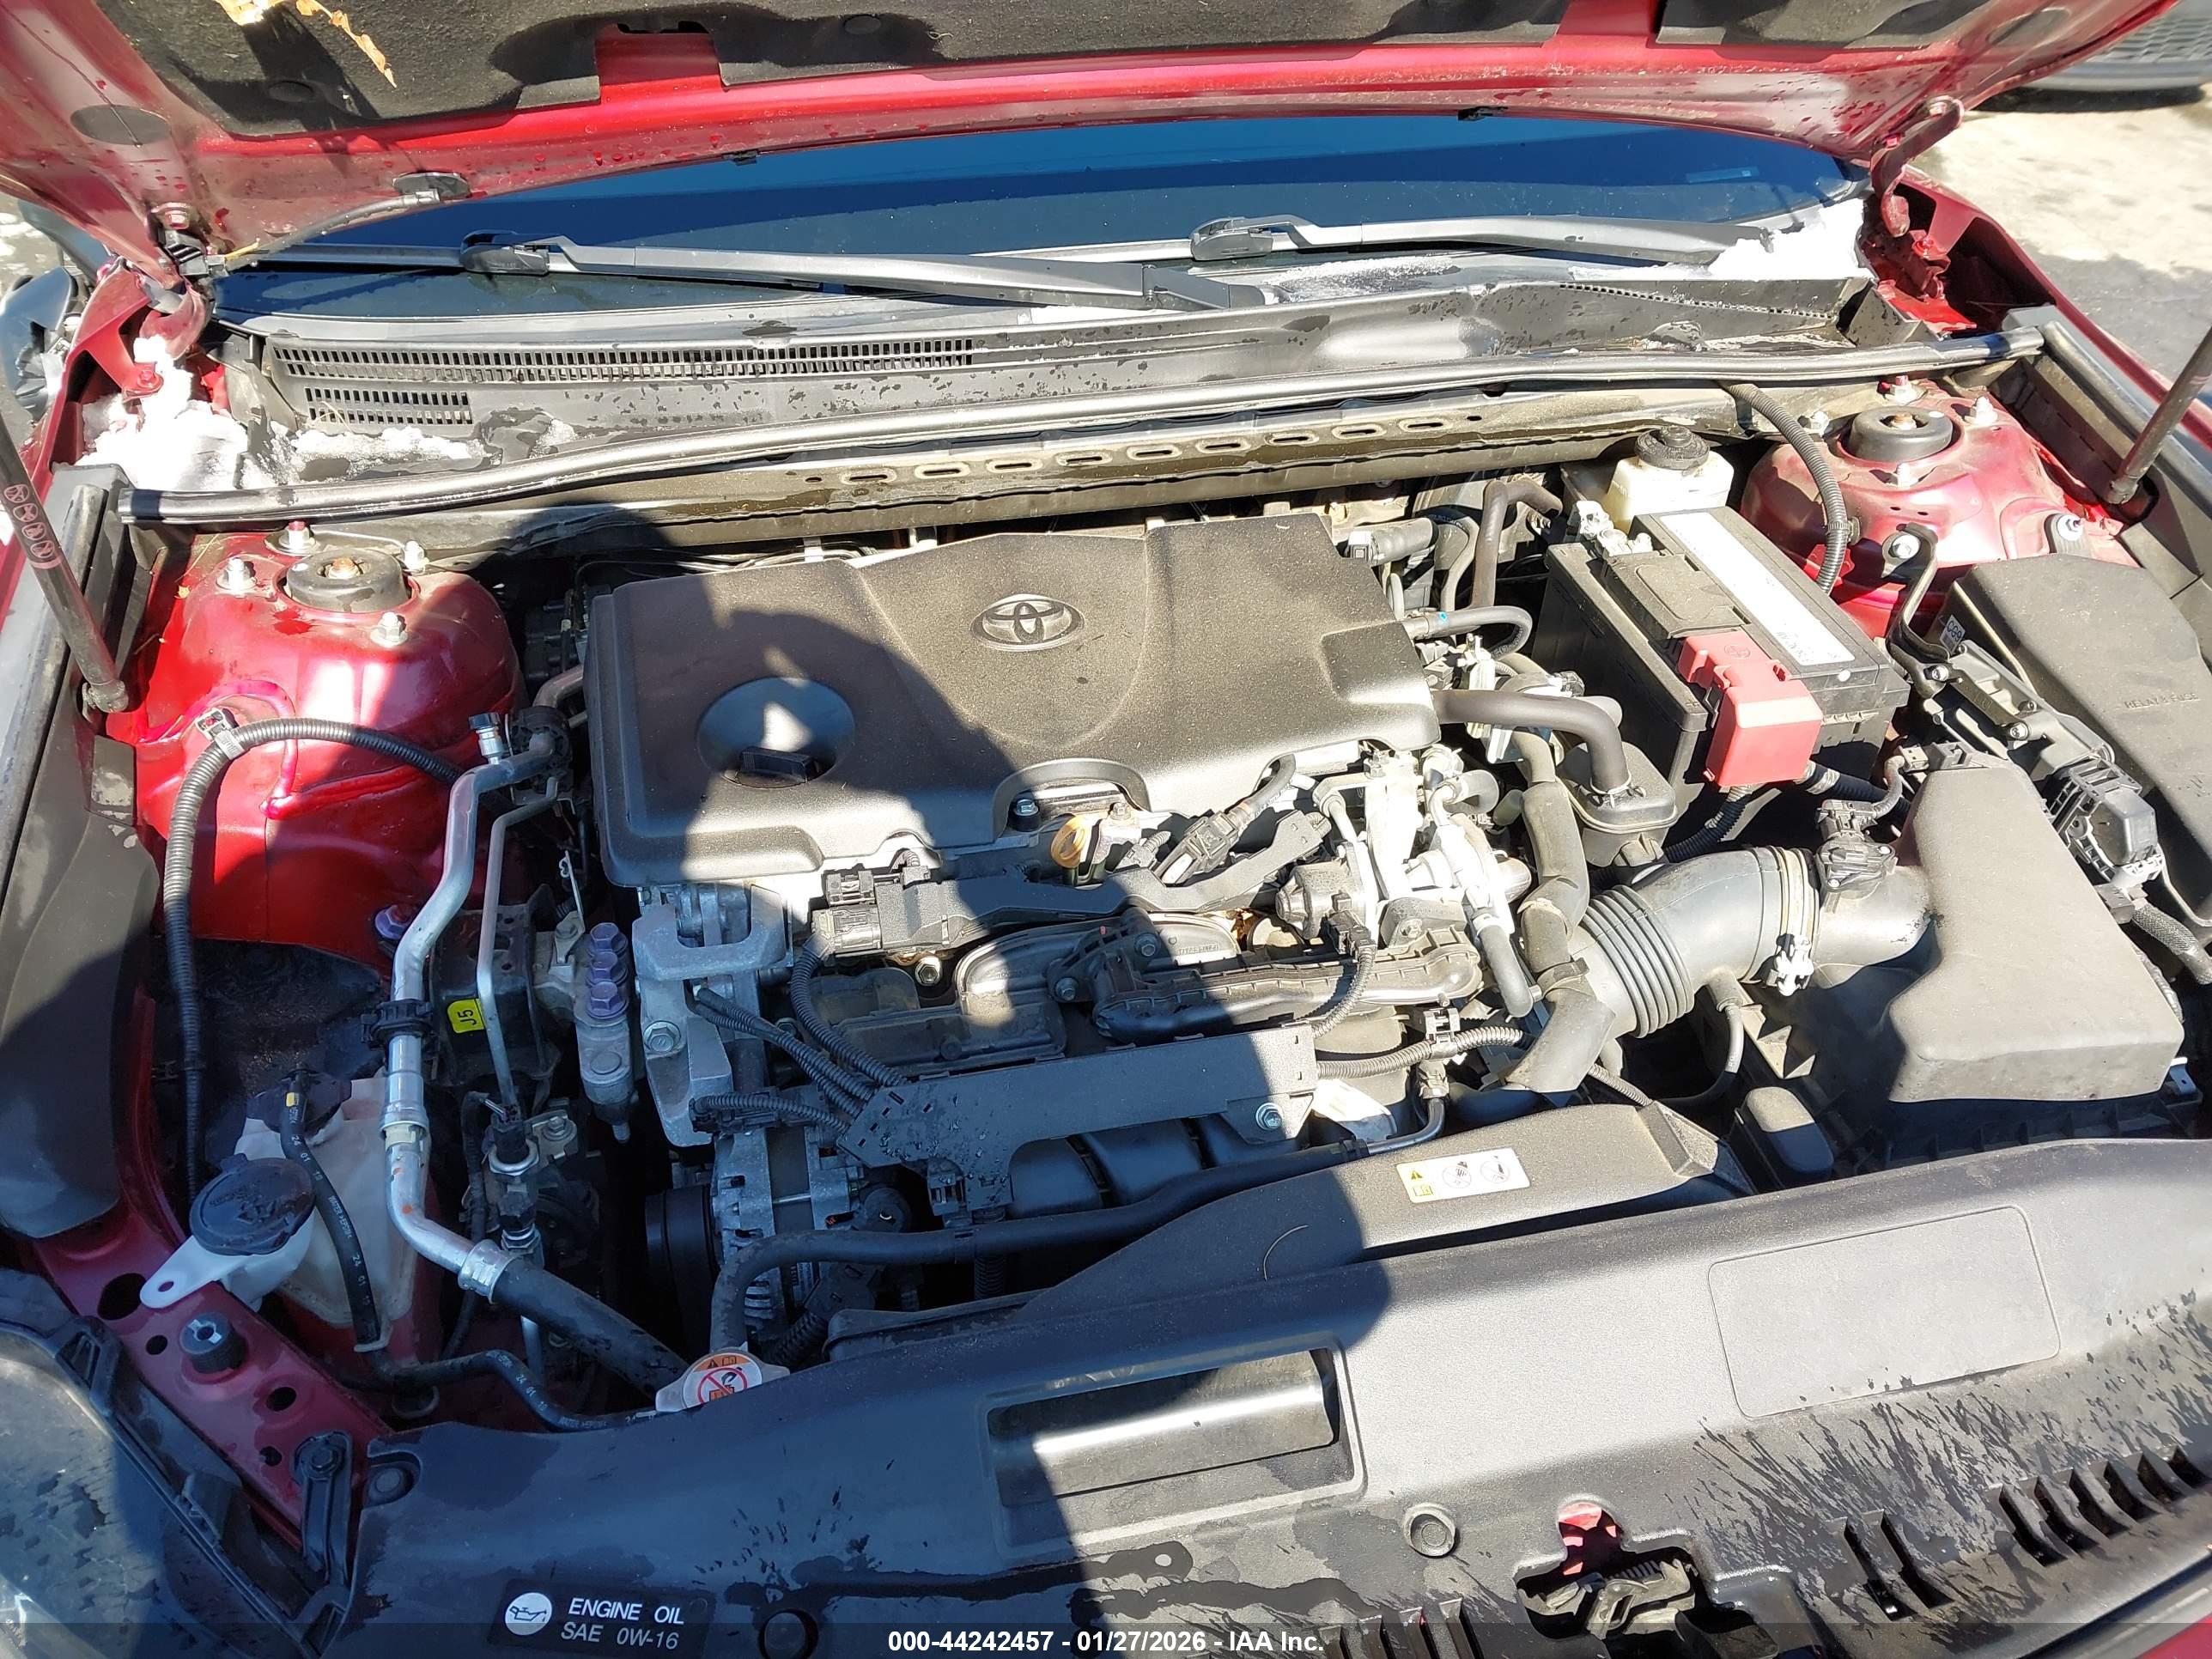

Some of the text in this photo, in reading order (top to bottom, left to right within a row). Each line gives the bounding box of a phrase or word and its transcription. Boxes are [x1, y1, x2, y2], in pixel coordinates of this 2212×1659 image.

[2124, 696, 2160, 709] RELAY
[457, 1009, 477, 1026] J5
[568, 1597, 685, 1626] ENGINE OIL
[561, 1621, 679, 1650] SAE 0W-16
